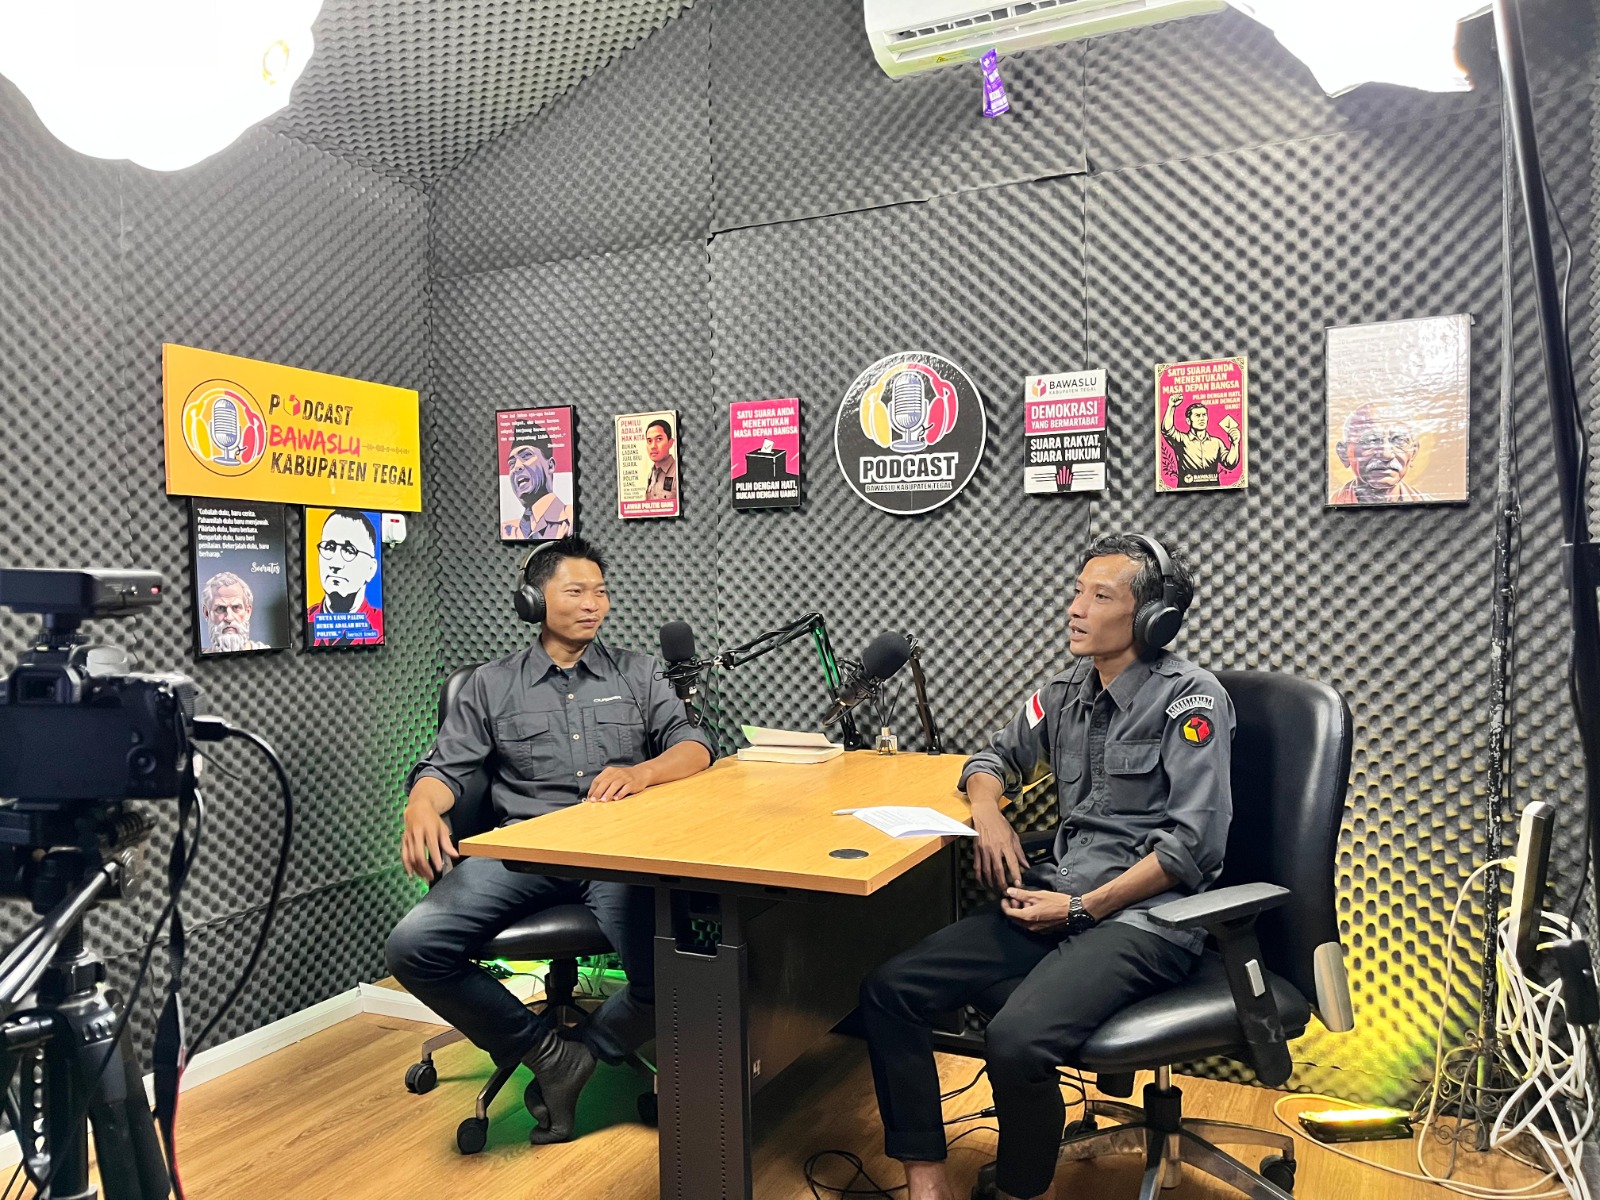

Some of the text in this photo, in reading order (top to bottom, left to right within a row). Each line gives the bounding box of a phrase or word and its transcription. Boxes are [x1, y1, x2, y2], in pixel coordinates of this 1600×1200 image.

[1168, 363, 1234, 377] SATU SUARA ANDA
[1050, 377, 1097, 389] BAWASLU
[1174, 373, 1227, 384] MENENTUKAN
[1163, 380, 1239, 394] MASA DEPAN BANGSA
[737, 407, 794, 419] SATU SUARA ANDA
[1031, 401, 1098, 419] DEMOKRASI
[742, 417, 789, 428] MENENTUKAN
[1031, 416, 1098, 429] YANG BERMARTABAT
[734, 426, 798, 438] MASA DEPAN BANGSA
[269, 424, 360, 457] BAWASLU
[1030, 434, 1101, 450] SUARA RAKYAT,
[1030, 447, 1100, 463] SUARA HUKUM
[270, 452, 414, 486] KABUPATEN TEGAL
[862, 456, 955, 480] PODCAST
[736, 480, 798, 491] PILIH DENGAN HATI,
[896, 482, 931, 490] KABUPATEN
[933, 481, 952, 489] TEGAL
[736, 490, 798, 500] BUKAN DENGAN UANG!
